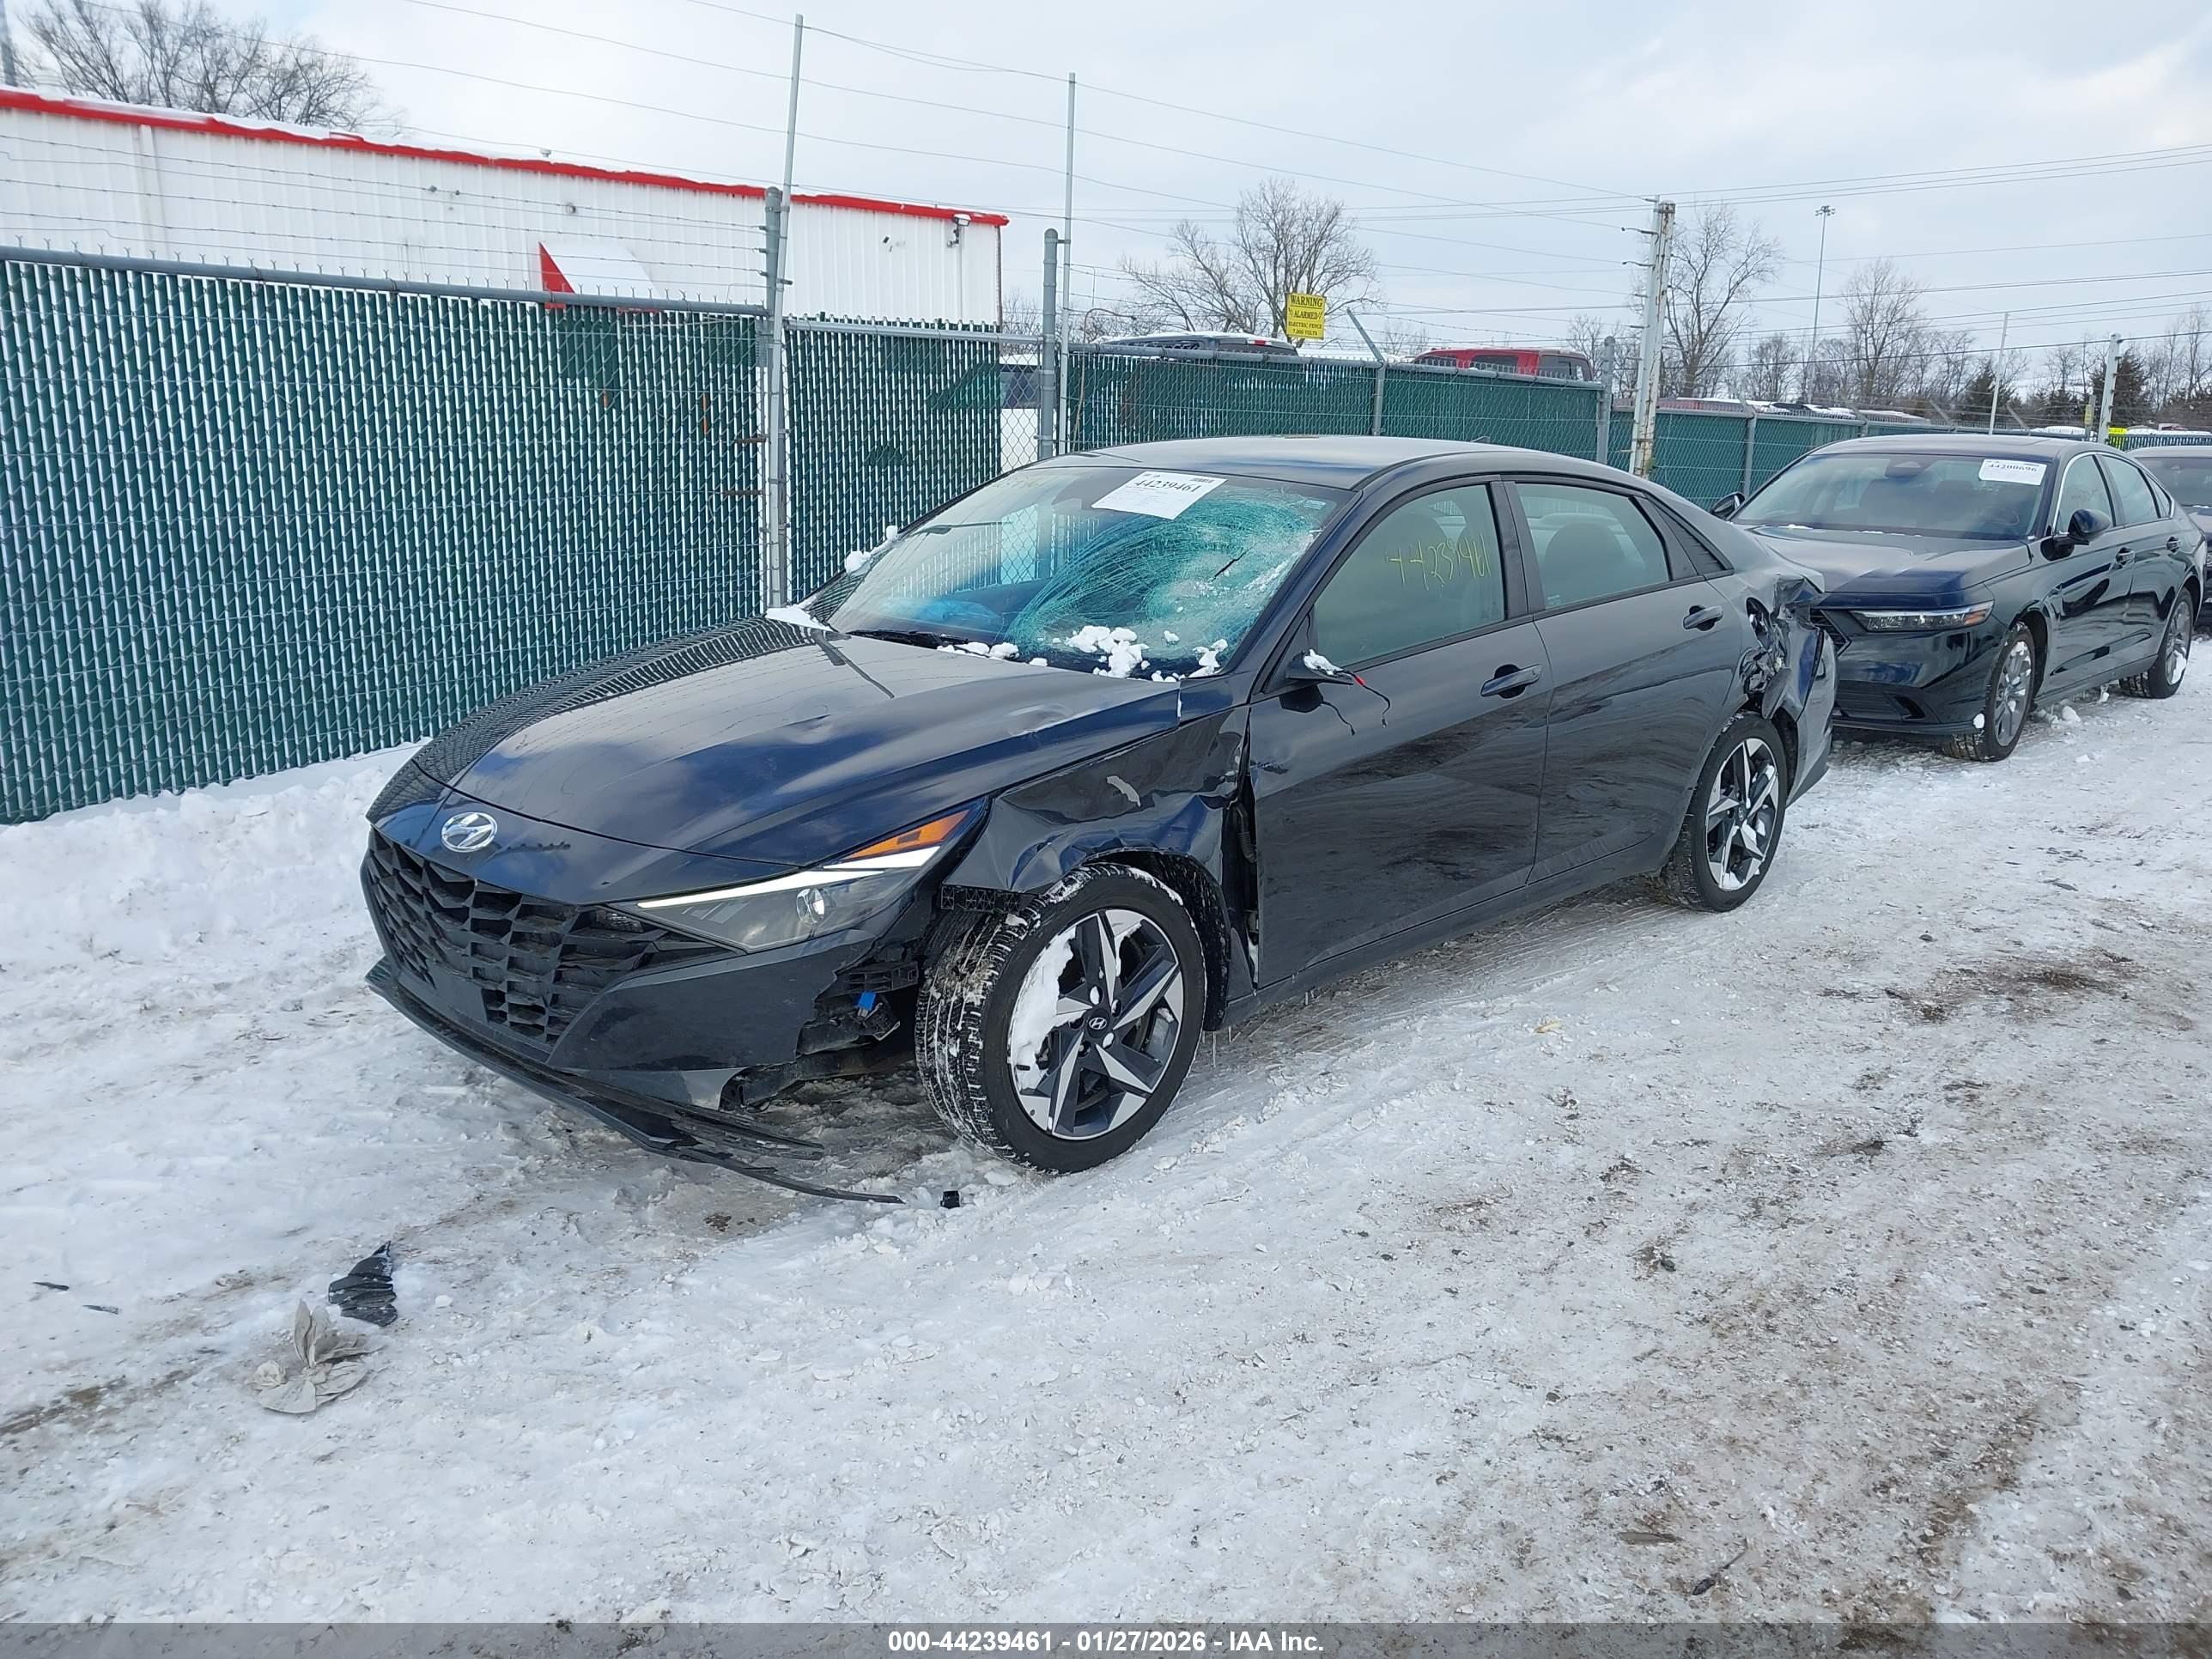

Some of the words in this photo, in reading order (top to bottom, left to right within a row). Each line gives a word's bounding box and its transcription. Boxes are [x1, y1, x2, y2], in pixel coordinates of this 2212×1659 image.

[1291, 295, 1322, 307] WARNING
[1293, 310, 1318, 319] ALARMED
[1134, 479, 1202, 493] 44239461
